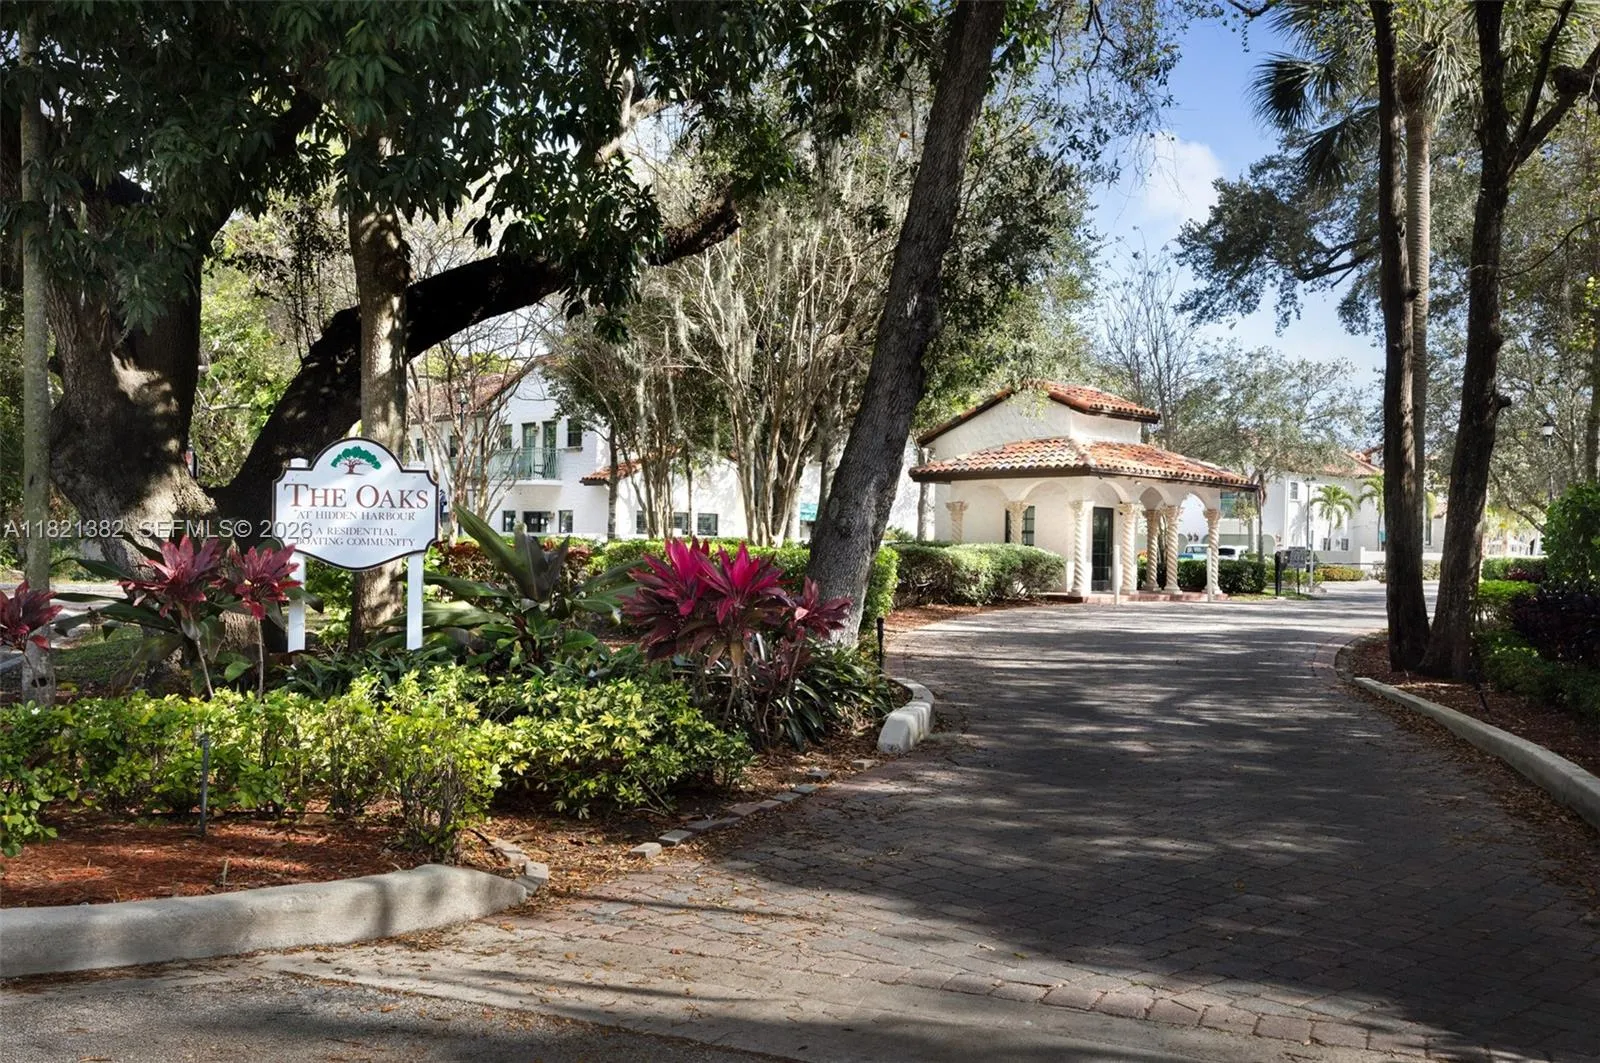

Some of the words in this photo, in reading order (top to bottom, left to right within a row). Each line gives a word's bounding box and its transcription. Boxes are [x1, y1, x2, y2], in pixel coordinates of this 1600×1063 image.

[284, 483, 347, 508] THE
[356, 484, 429, 509] OAKS
[297, 511, 313, 520] AT
[315, 511, 358, 520] HIDDEN
[361, 511, 416, 521] HARBOUR
[315, 527, 324, 536] A
[327, 527, 397, 536] RESIDENTIAL
[296, 537, 344, 546] BOATING
[346, 537, 416, 547] COMMUNITY
